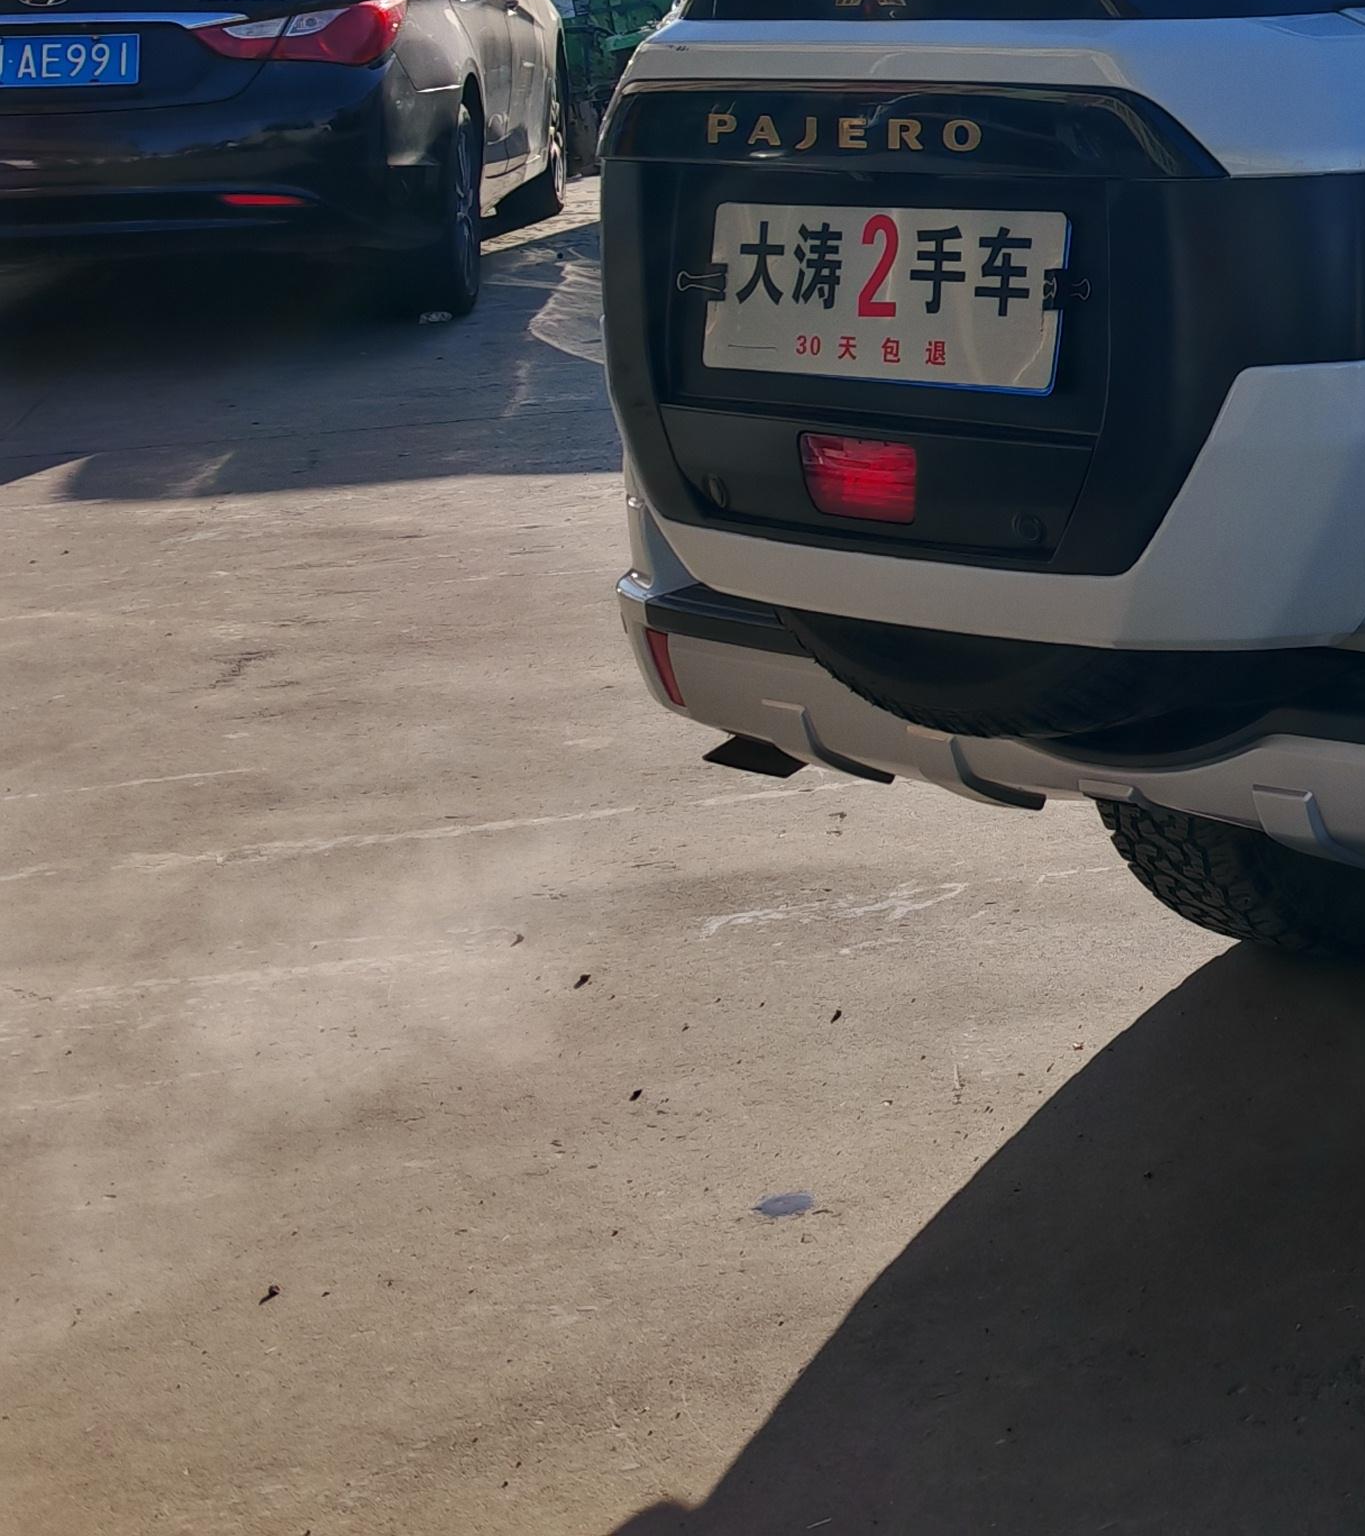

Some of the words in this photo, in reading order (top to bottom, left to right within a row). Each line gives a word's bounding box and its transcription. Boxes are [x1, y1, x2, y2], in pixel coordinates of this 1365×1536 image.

[706, 113, 983, 153] PAJERO
[735, 214, 1033, 318] 大涛2手车
